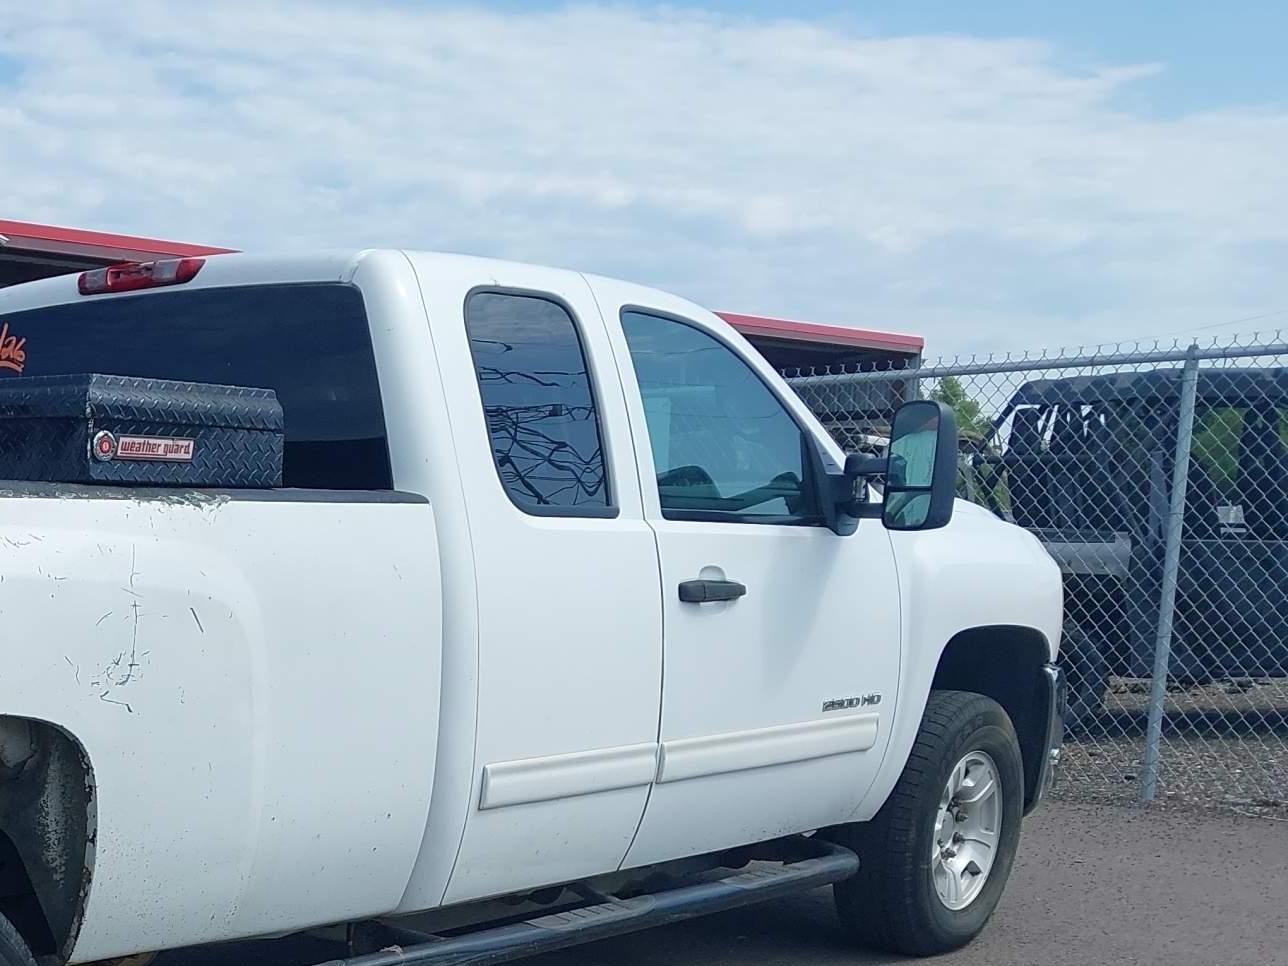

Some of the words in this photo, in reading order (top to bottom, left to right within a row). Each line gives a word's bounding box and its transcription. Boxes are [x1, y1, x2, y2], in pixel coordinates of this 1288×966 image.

[120, 440, 162, 453] weather
[162, 442, 190, 457] guard
[861, 693, 881, 706] HD
